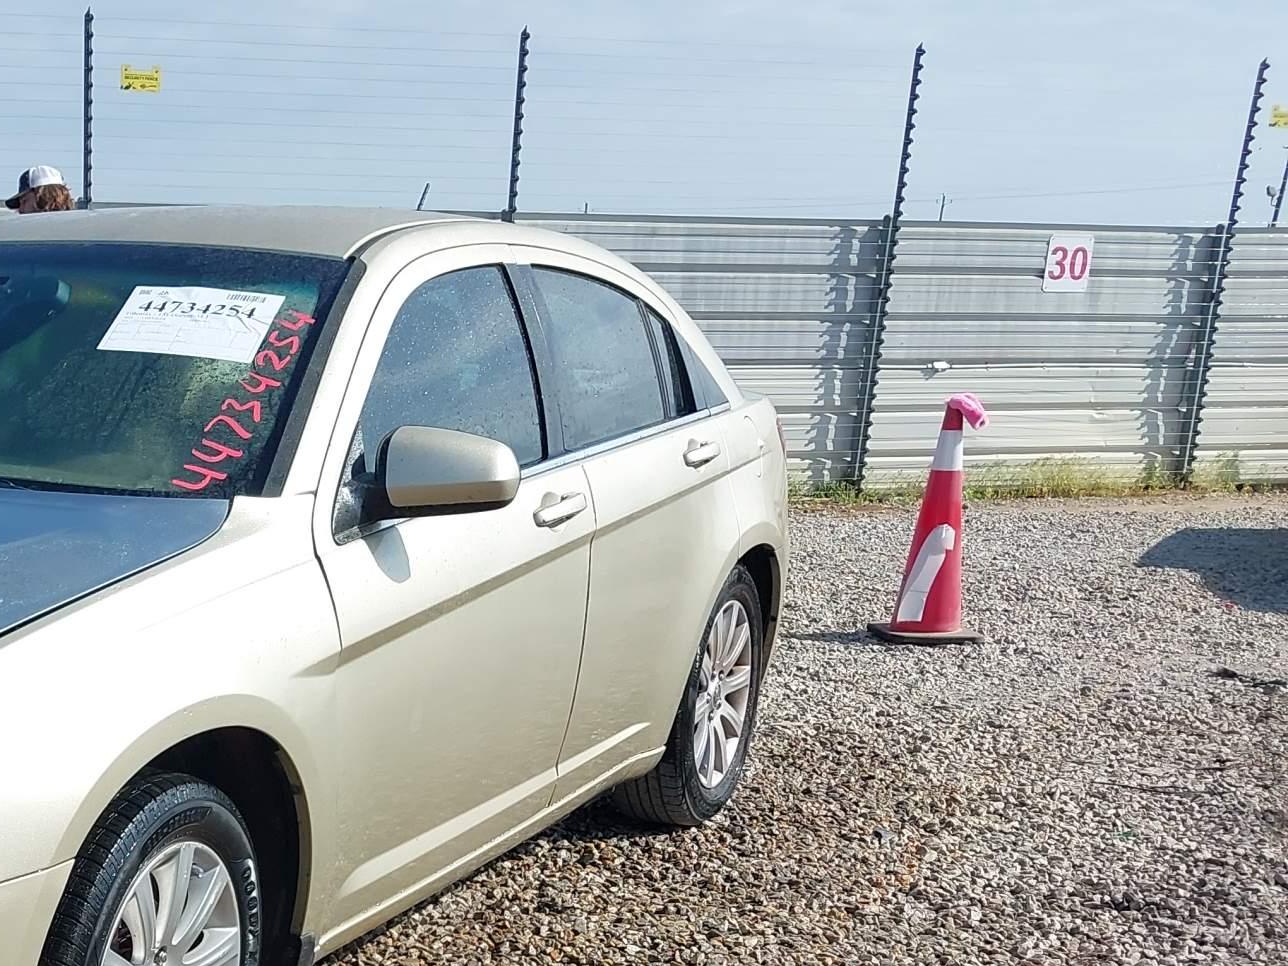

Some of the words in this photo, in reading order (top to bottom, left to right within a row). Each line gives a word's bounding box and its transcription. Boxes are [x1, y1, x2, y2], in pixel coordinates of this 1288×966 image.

[1048, 246, 1088, 281] 30
[138, 300, 257, 319] 44734254
[170, 309, 316, 491] 44734254
